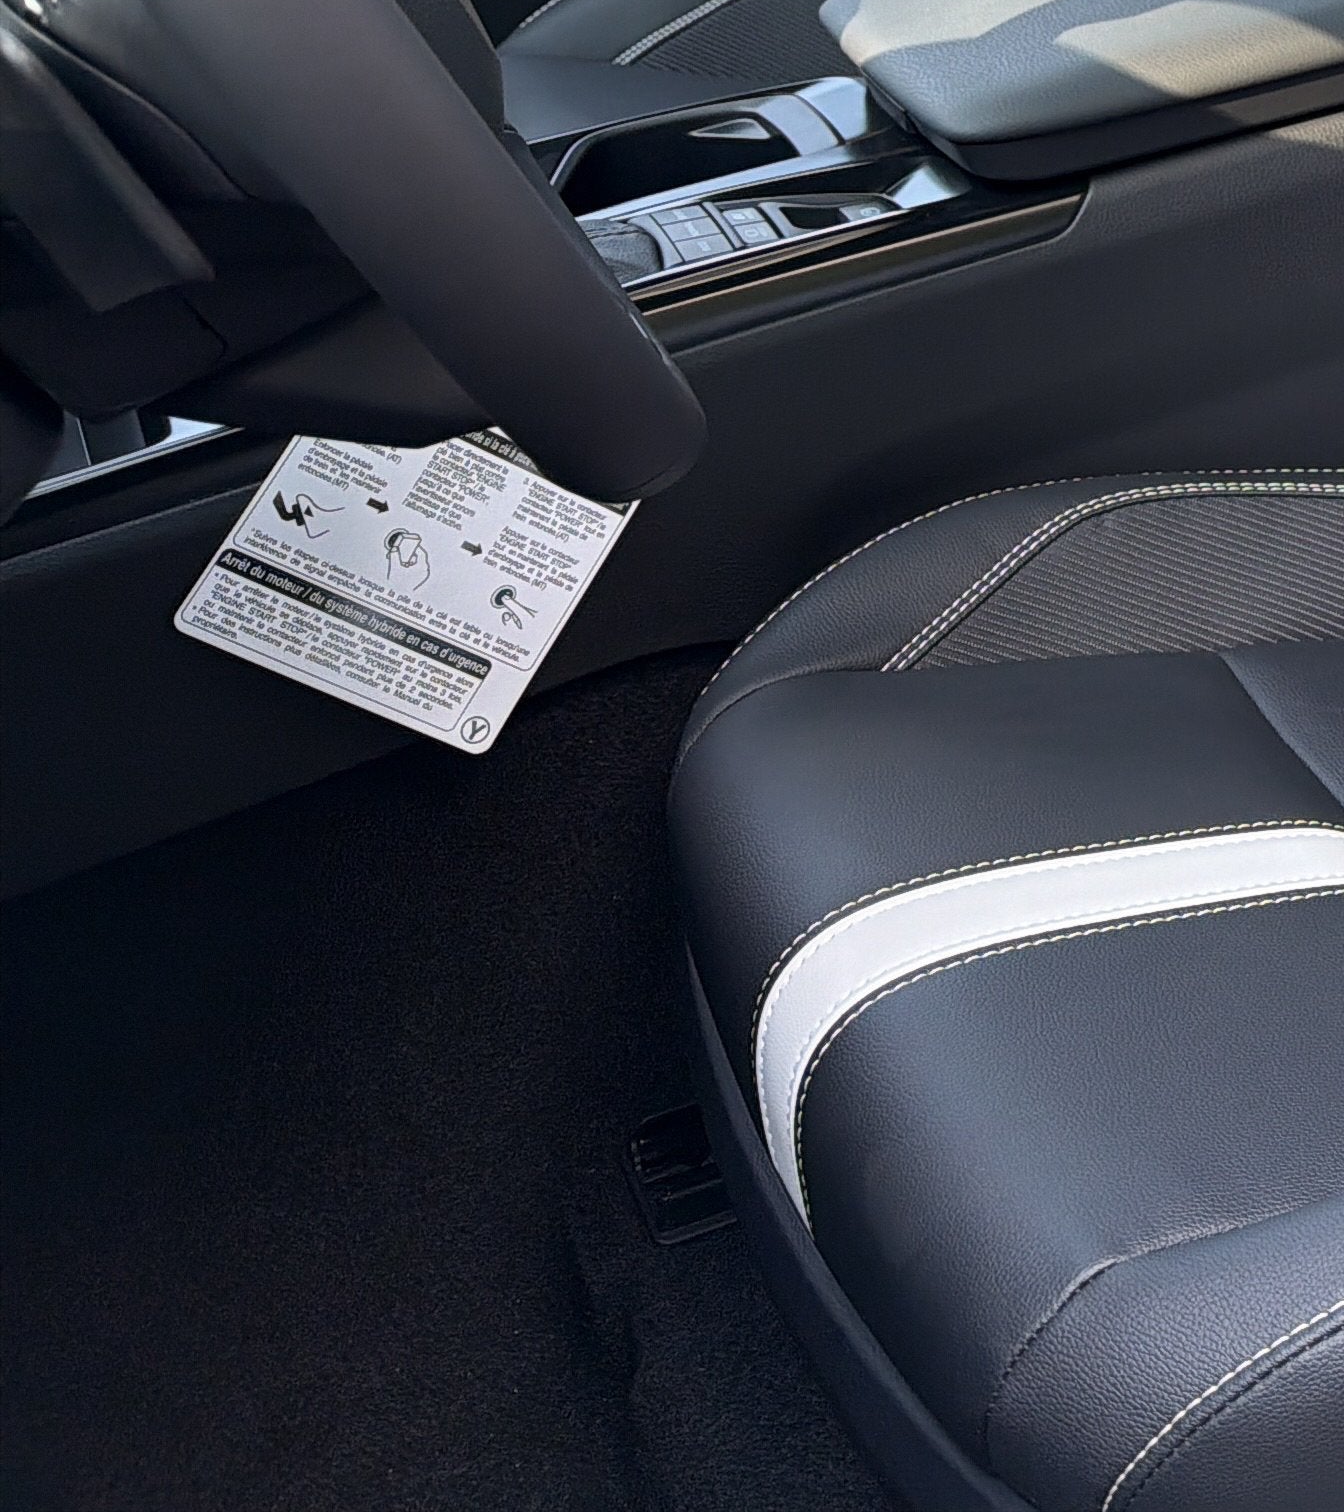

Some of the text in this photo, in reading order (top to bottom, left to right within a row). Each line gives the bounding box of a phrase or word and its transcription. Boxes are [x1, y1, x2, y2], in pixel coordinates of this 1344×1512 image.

[220, 550, 251, 573] Arrêt
[249, 563, 266, 580] du
[265, 570, 306, 597] moteur
[308, 589, 326, 605] du
[322, 595, 369, 627] système
[365, 613, 410, 645] hybride
[406, 633, 421, 646] en
[420, 639, 440, 654] cas
[438, 646, 489, 679] d'urgence
[468, 719, 487, 741] Y
